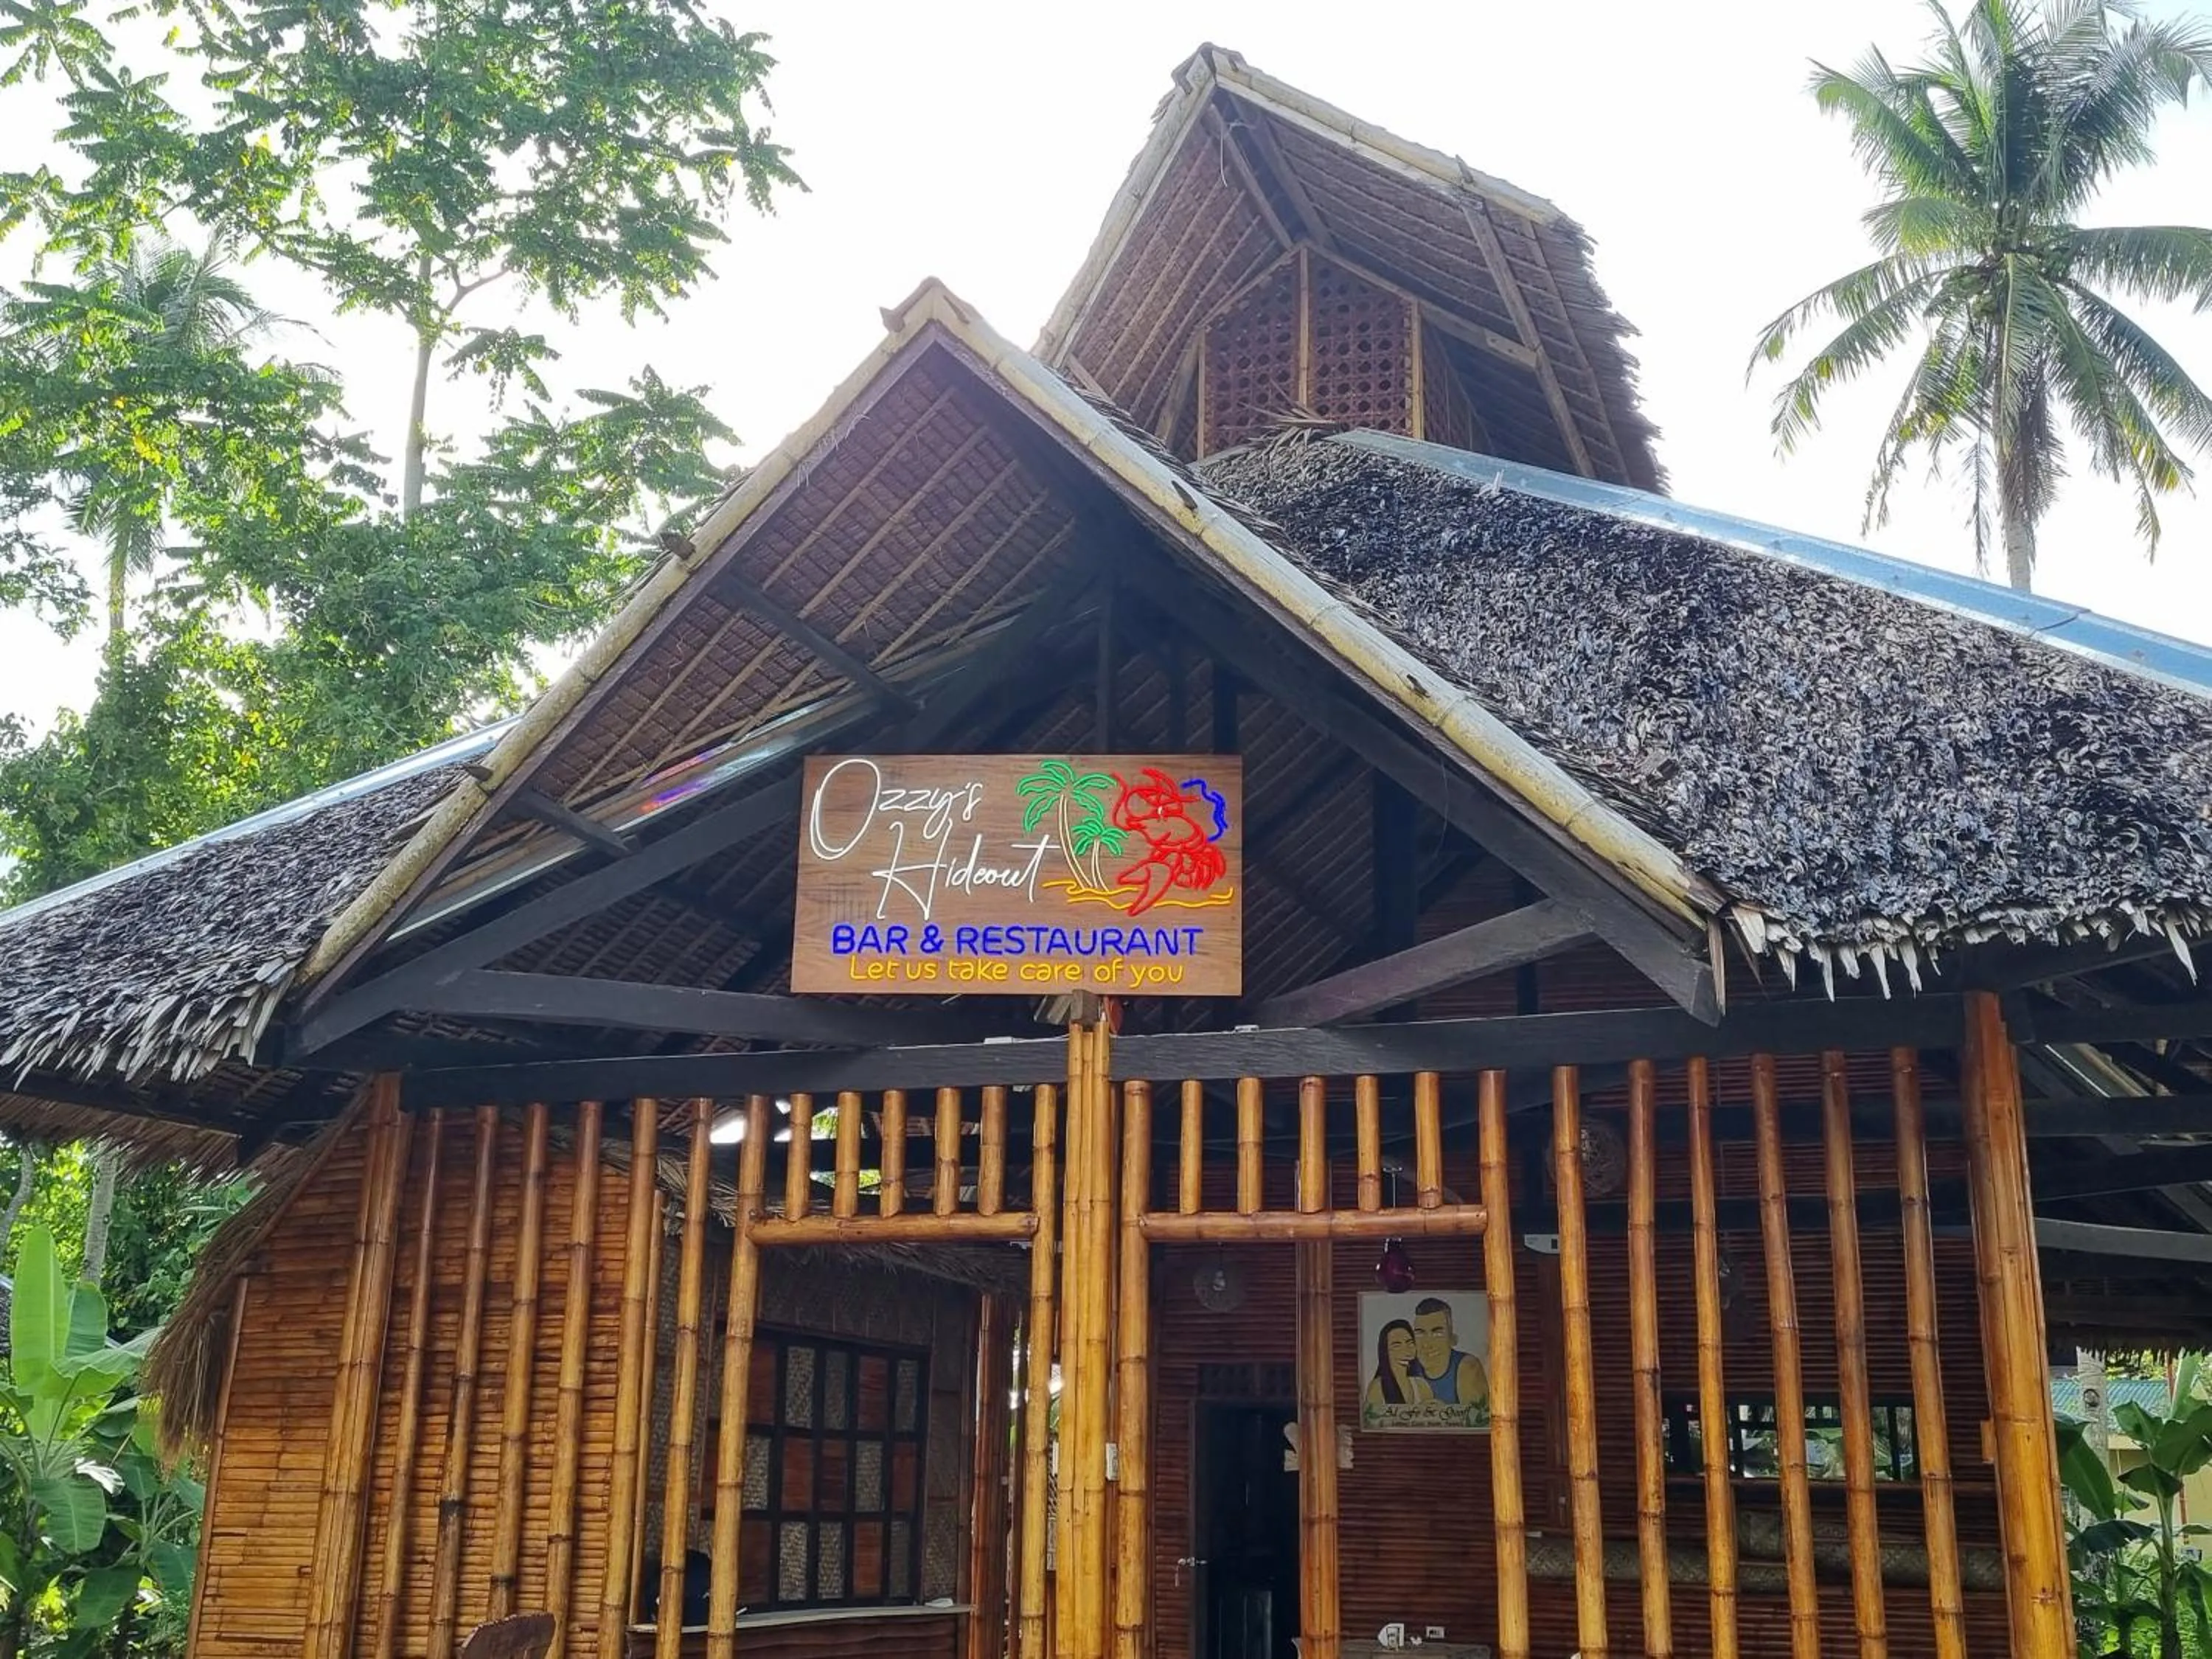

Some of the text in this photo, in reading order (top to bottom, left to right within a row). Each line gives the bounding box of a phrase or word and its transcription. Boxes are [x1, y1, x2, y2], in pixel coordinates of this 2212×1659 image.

[810, 758, 983, 860] Ozzy's
[872, 818, 1061, 921] Hideout
[832, 925, 1204, 956] BAR & RESTAURANT
[850, 956, 1184, 987] Let us take care of you
